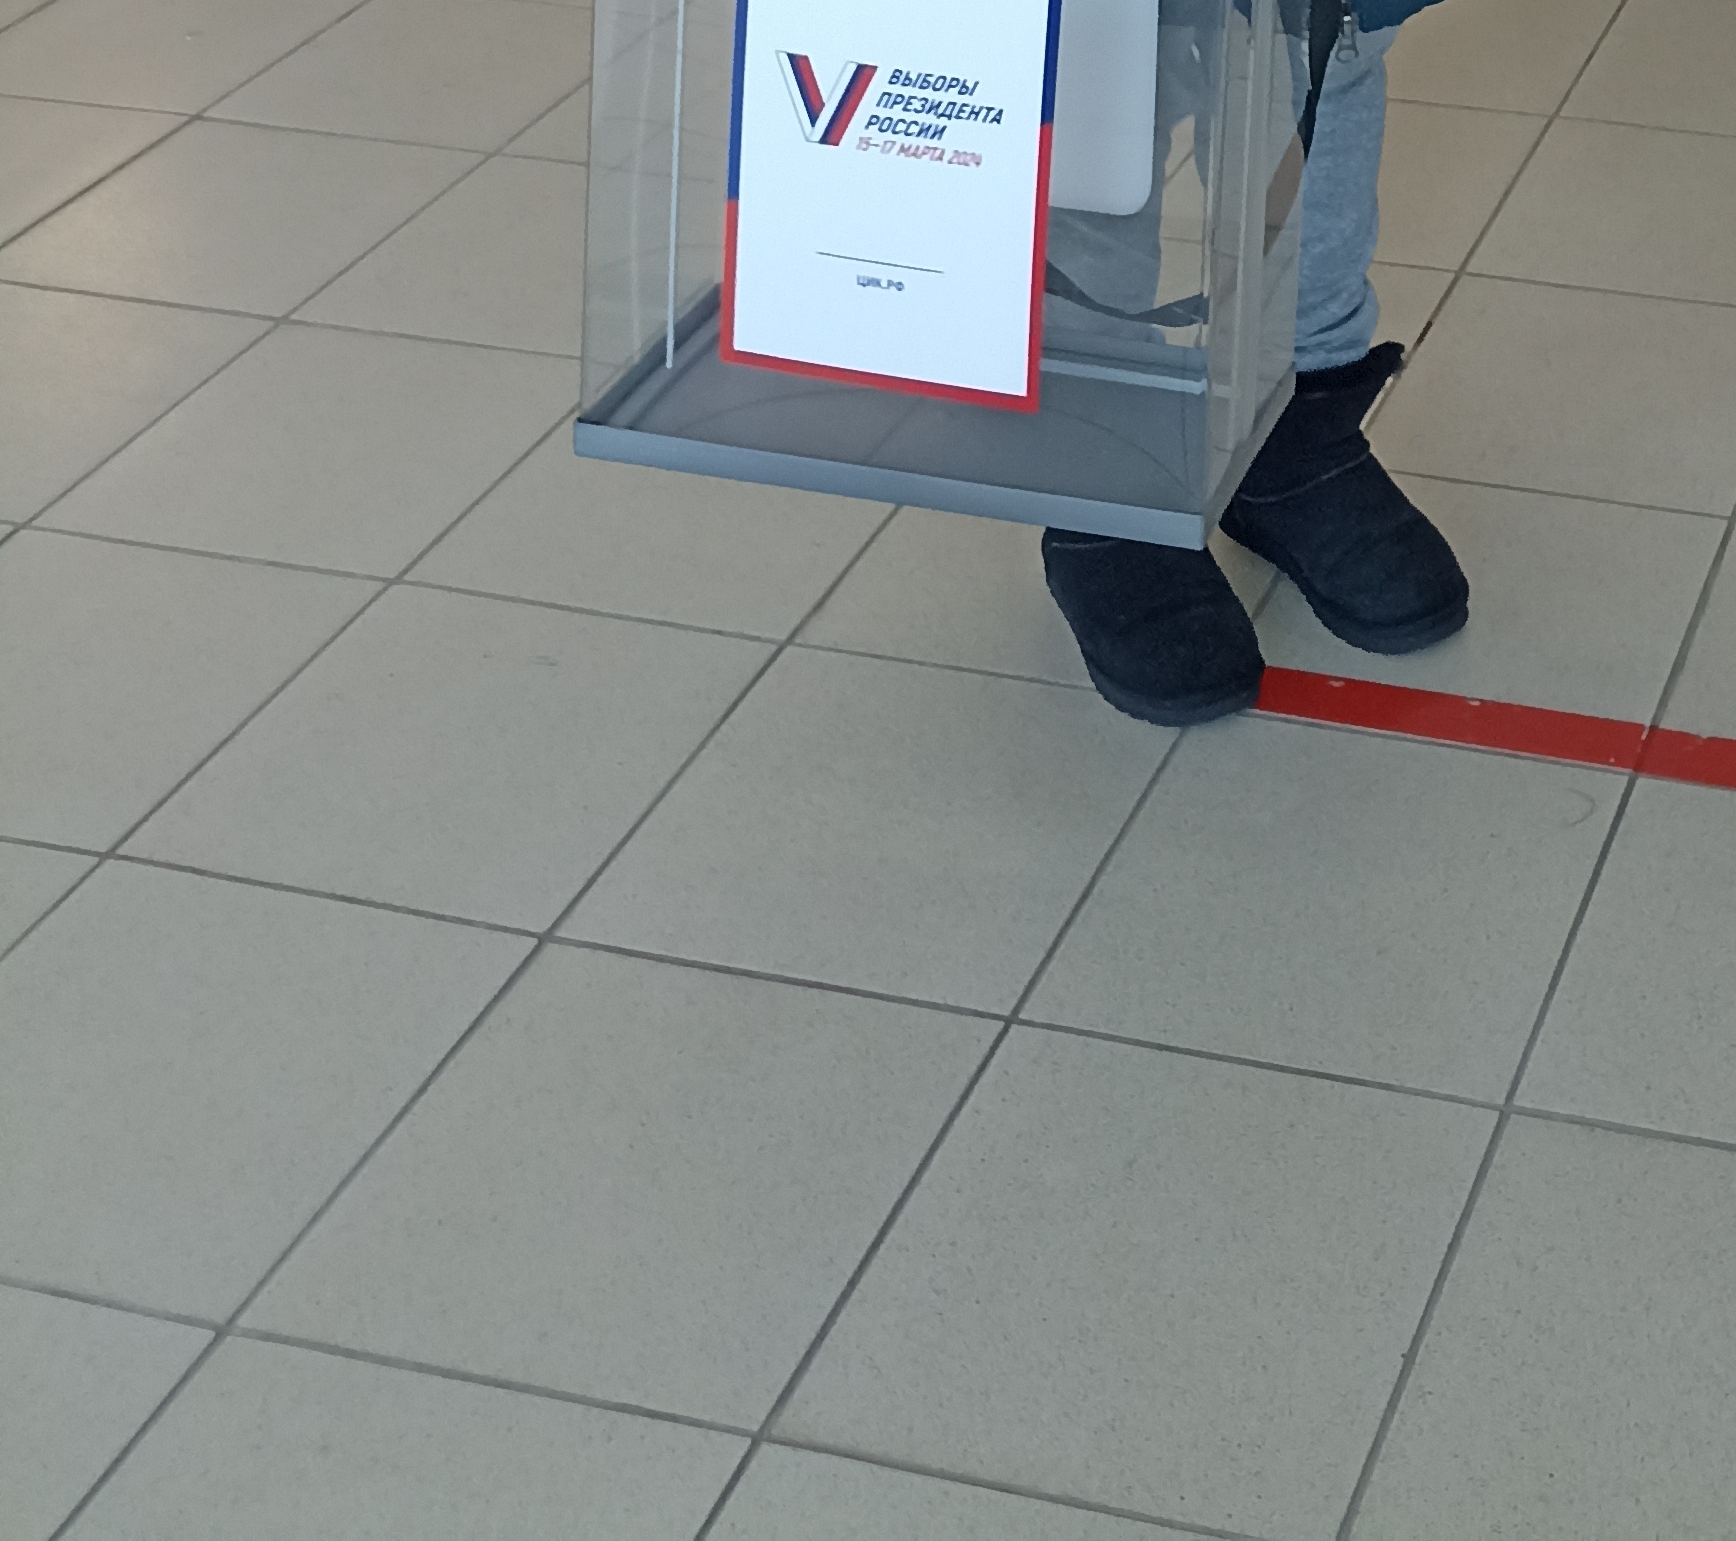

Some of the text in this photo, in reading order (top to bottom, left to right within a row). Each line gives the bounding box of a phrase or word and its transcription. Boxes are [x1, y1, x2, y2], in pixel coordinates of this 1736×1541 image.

[888, 68, 980, 97] ВЫБОРЫ
[875, 91, 1004, 125] ПРЕЗИДЕНТА
[864, 114, 947, 141] РОССИИ
[896, 143, 946, 163] МАРТА
